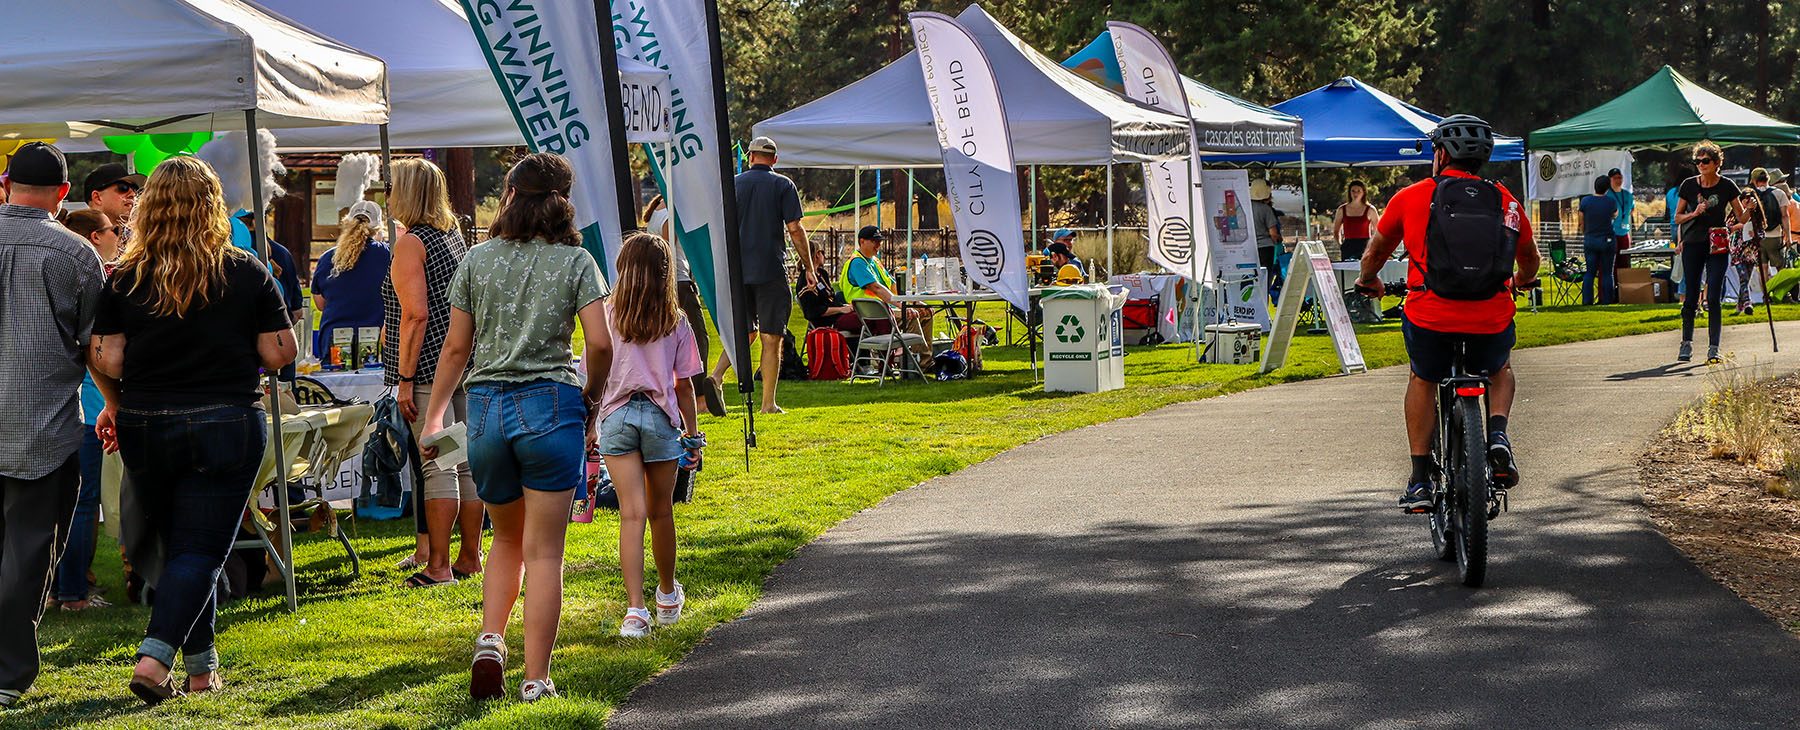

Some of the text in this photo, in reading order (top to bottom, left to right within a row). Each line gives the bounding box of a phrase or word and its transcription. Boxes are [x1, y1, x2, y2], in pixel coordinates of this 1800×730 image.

[493, 31, 566, 155] WATER
[622, 83, 661, 132] BEND
[1205, 126, 1296, 148] cascades east transit
